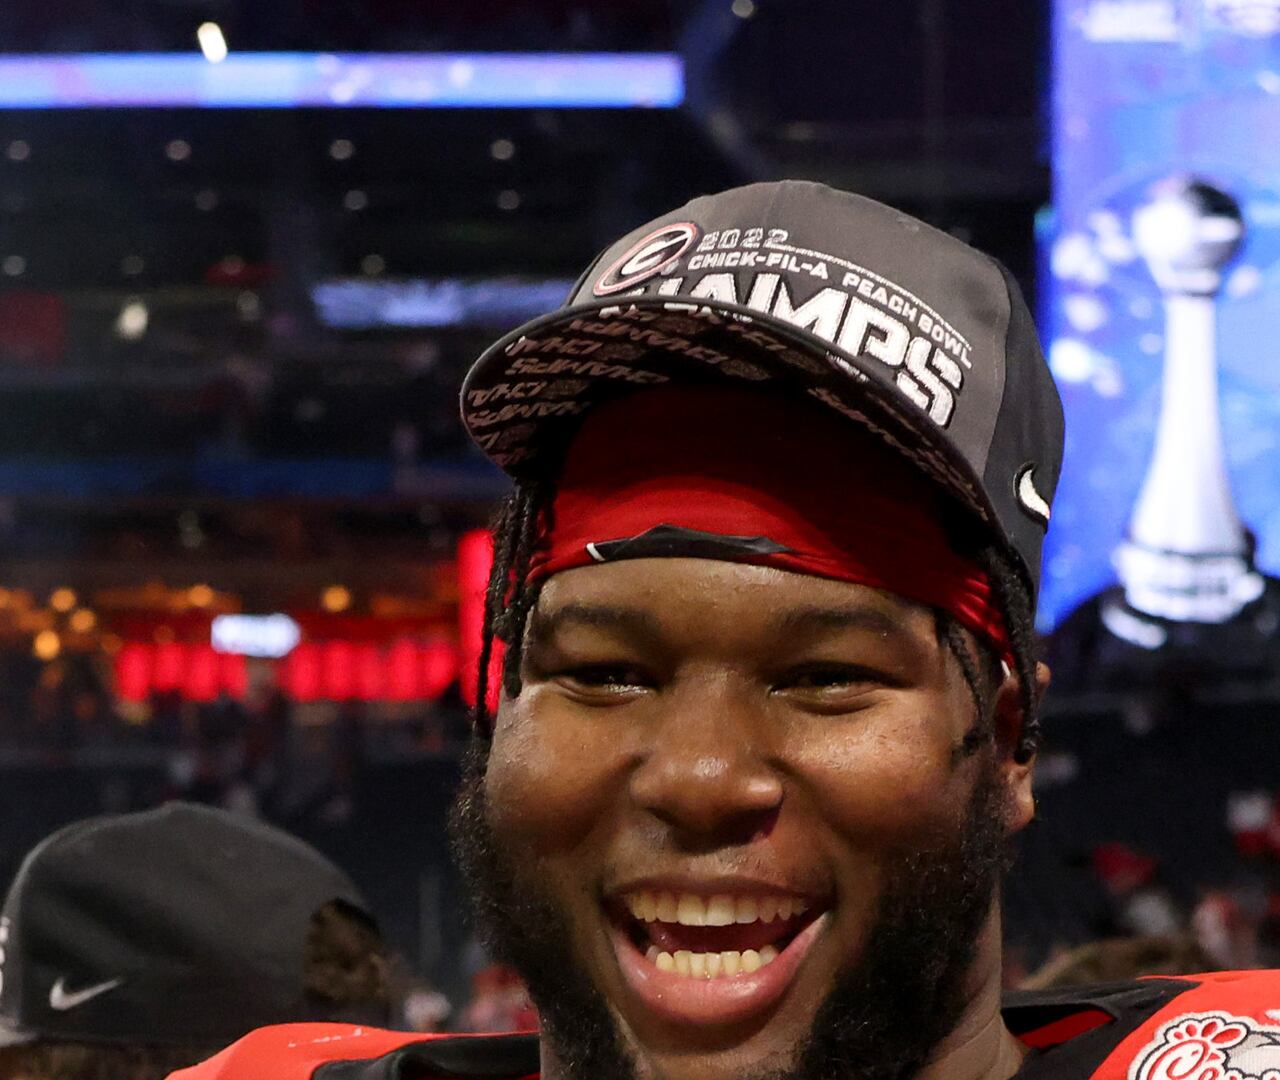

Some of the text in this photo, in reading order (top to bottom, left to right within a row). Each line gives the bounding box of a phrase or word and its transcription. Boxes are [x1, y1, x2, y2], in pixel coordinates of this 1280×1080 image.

[697, 227, 790, 253] 2022
[687, 250, 972, 369] CHICK-FIL-A PEACH BOWL
